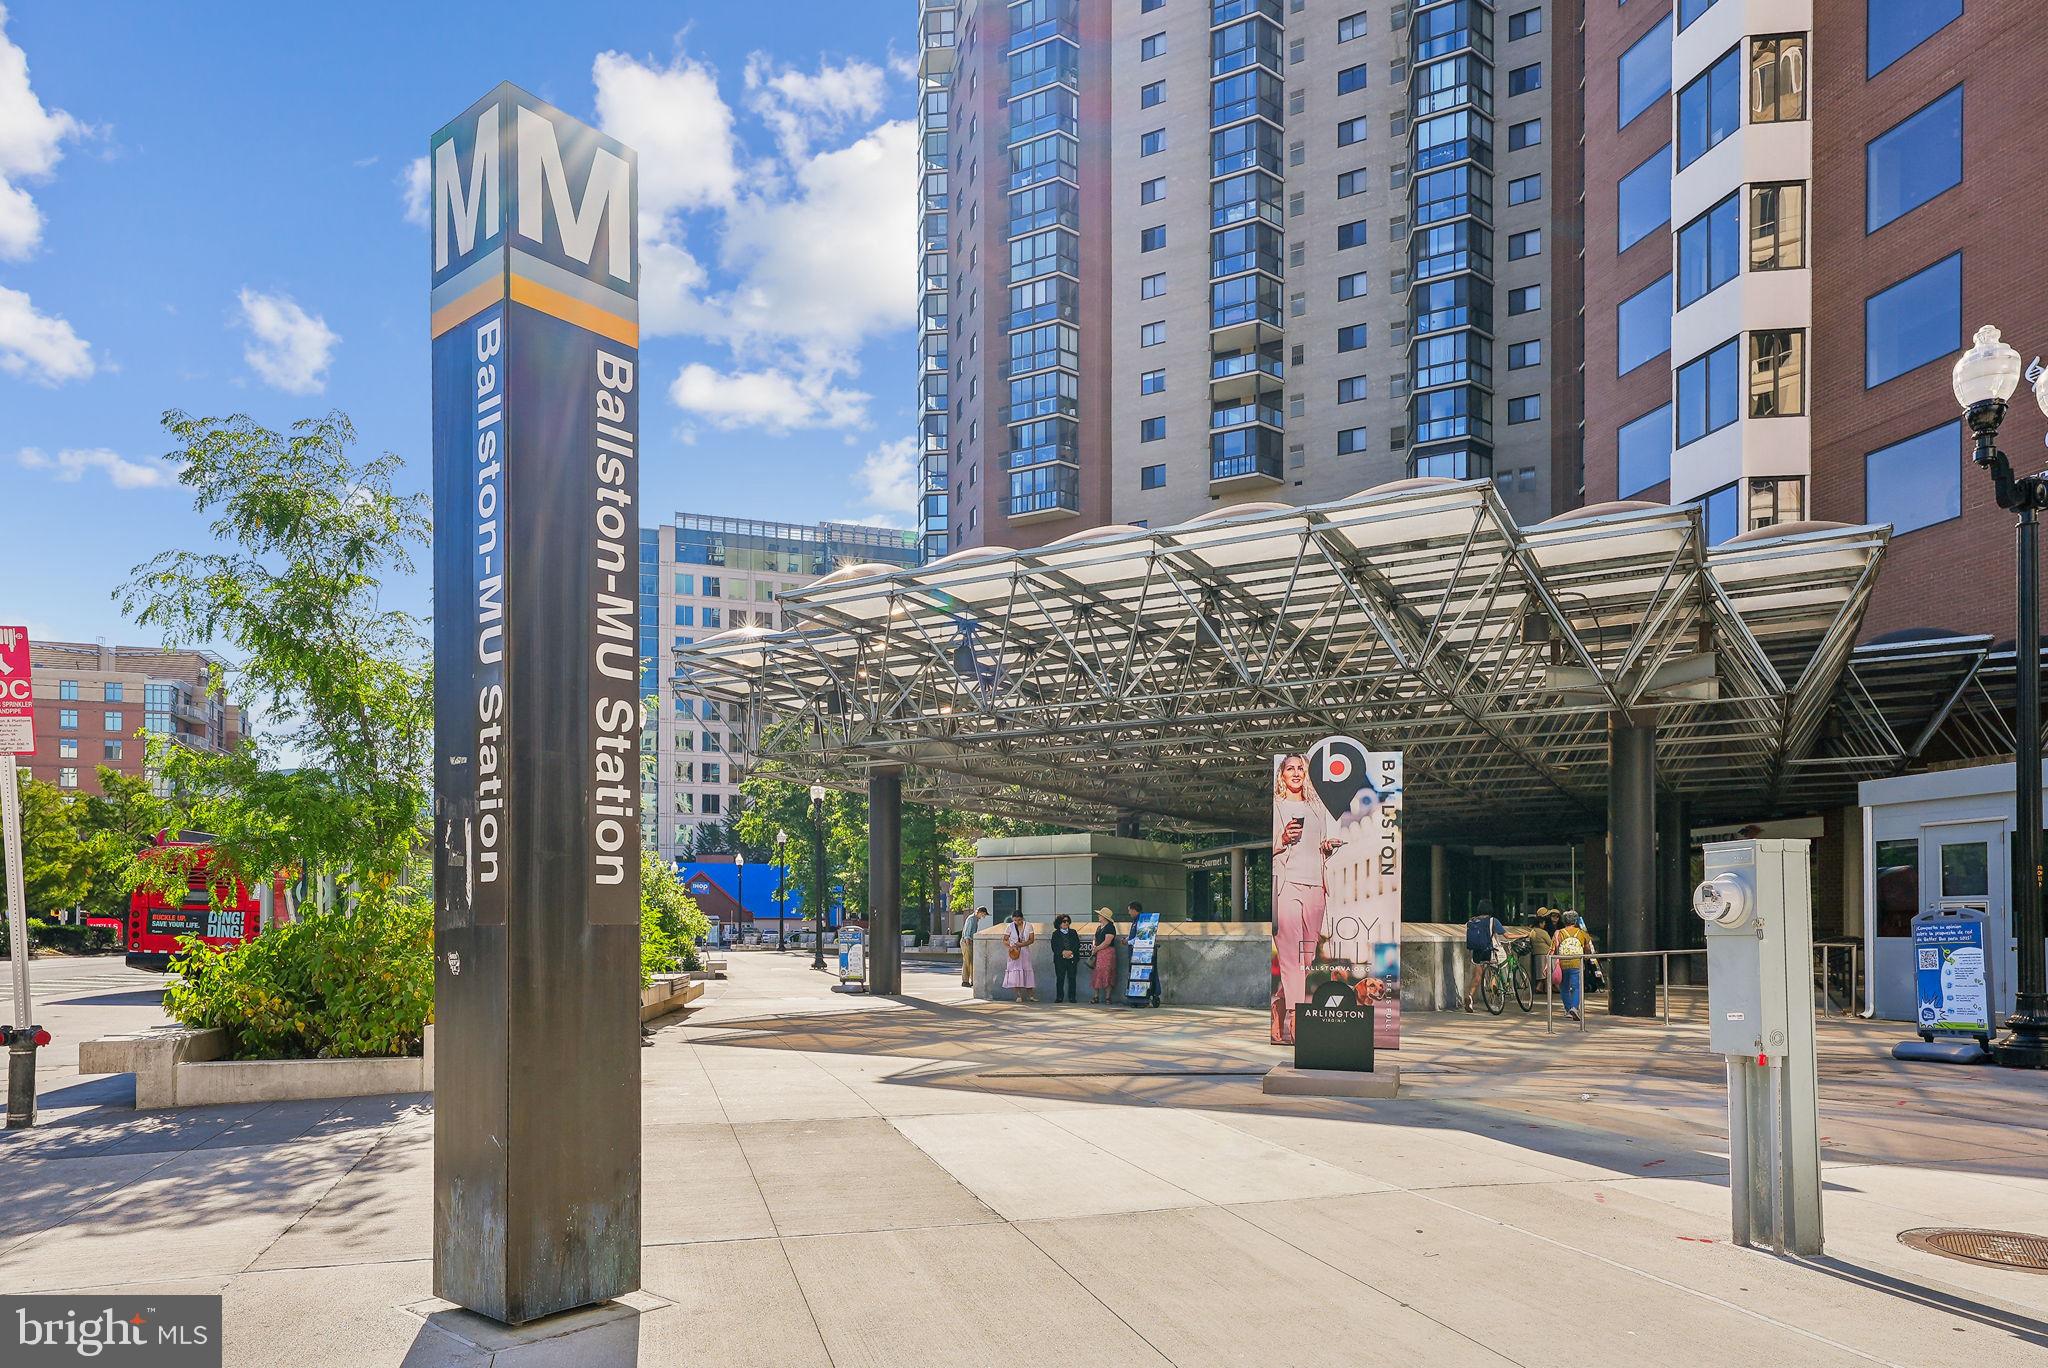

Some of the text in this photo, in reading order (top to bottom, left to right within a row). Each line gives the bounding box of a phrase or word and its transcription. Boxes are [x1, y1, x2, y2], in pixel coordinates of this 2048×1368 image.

[435, 102, 500, 272] M
[517, 104, 632, 284] M
[477, 317, 503, 883] Ballston-MU Station
[595, 349, 634, 885] Ballston-MU Station
[1381, 760, 1396, 876] BALLSTON
[208, 911, 246, 924] DING!
[1326, 916, 1379, 940] JOY
[207, 924, 244, 938] DING!
[1298, 940, 1373, 964] FULL
[1300, 964, 1371, 972] BALLSTONVA.ORG
[1305, 1009, 1364, 1019] ARLINGTON
